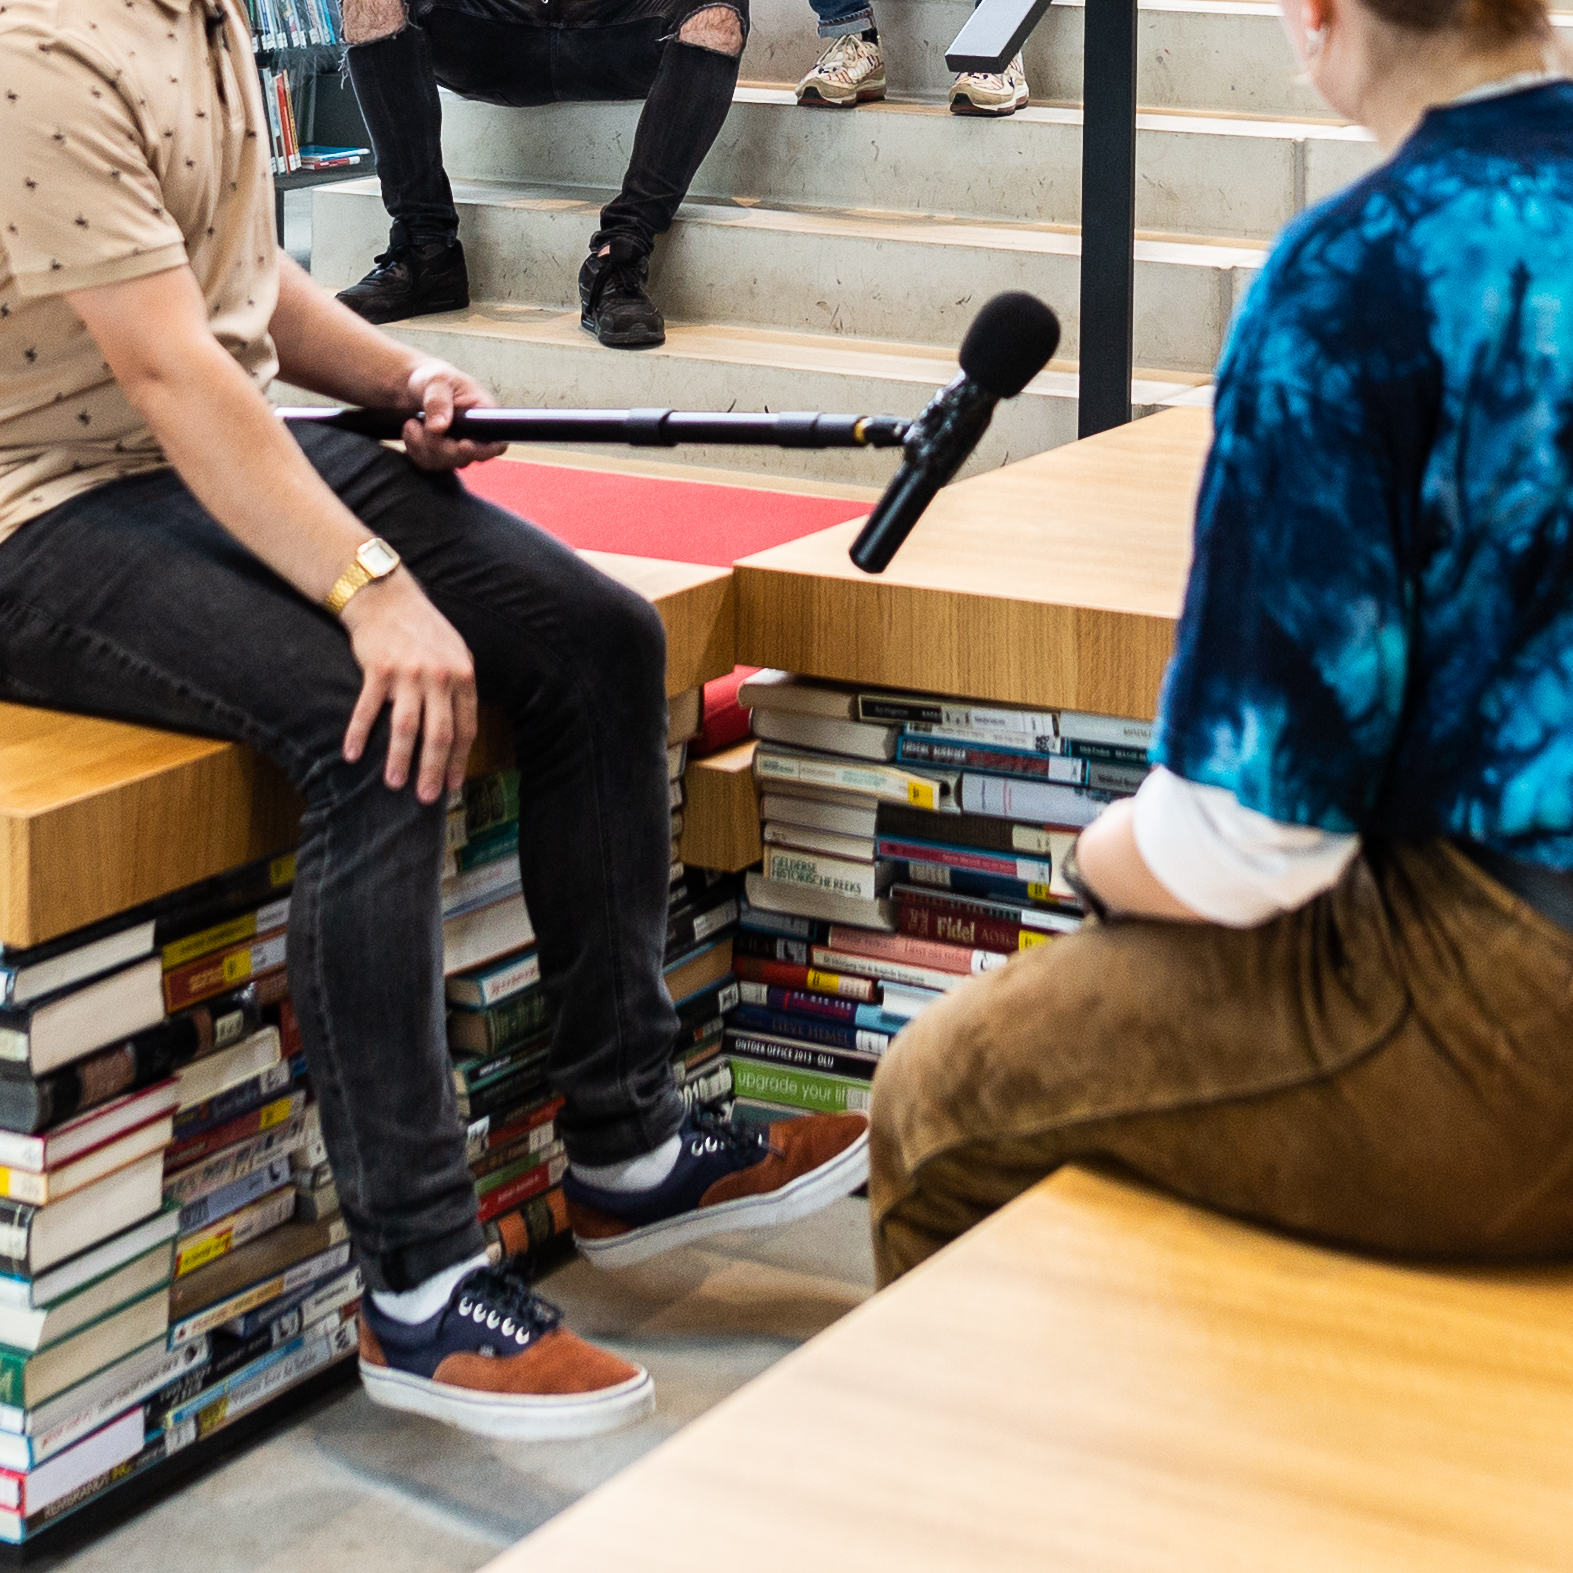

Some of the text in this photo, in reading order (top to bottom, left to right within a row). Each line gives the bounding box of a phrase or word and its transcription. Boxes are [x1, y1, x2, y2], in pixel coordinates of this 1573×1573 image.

[771, 855, 818, 874] GELDERSE
[771, 867, 862, 894] HISTORISCHE REEKS
[937, 916, 975, 943] Fidel
[735, 1039, 766, 1056] ONTDEK
[767, 1043, 793, 1061] OFFICE
[793, 1047, 812, 1064] 2013
[737, 1069, 799, 1099] upgrade
[801, 1077, 832, 1102] your
